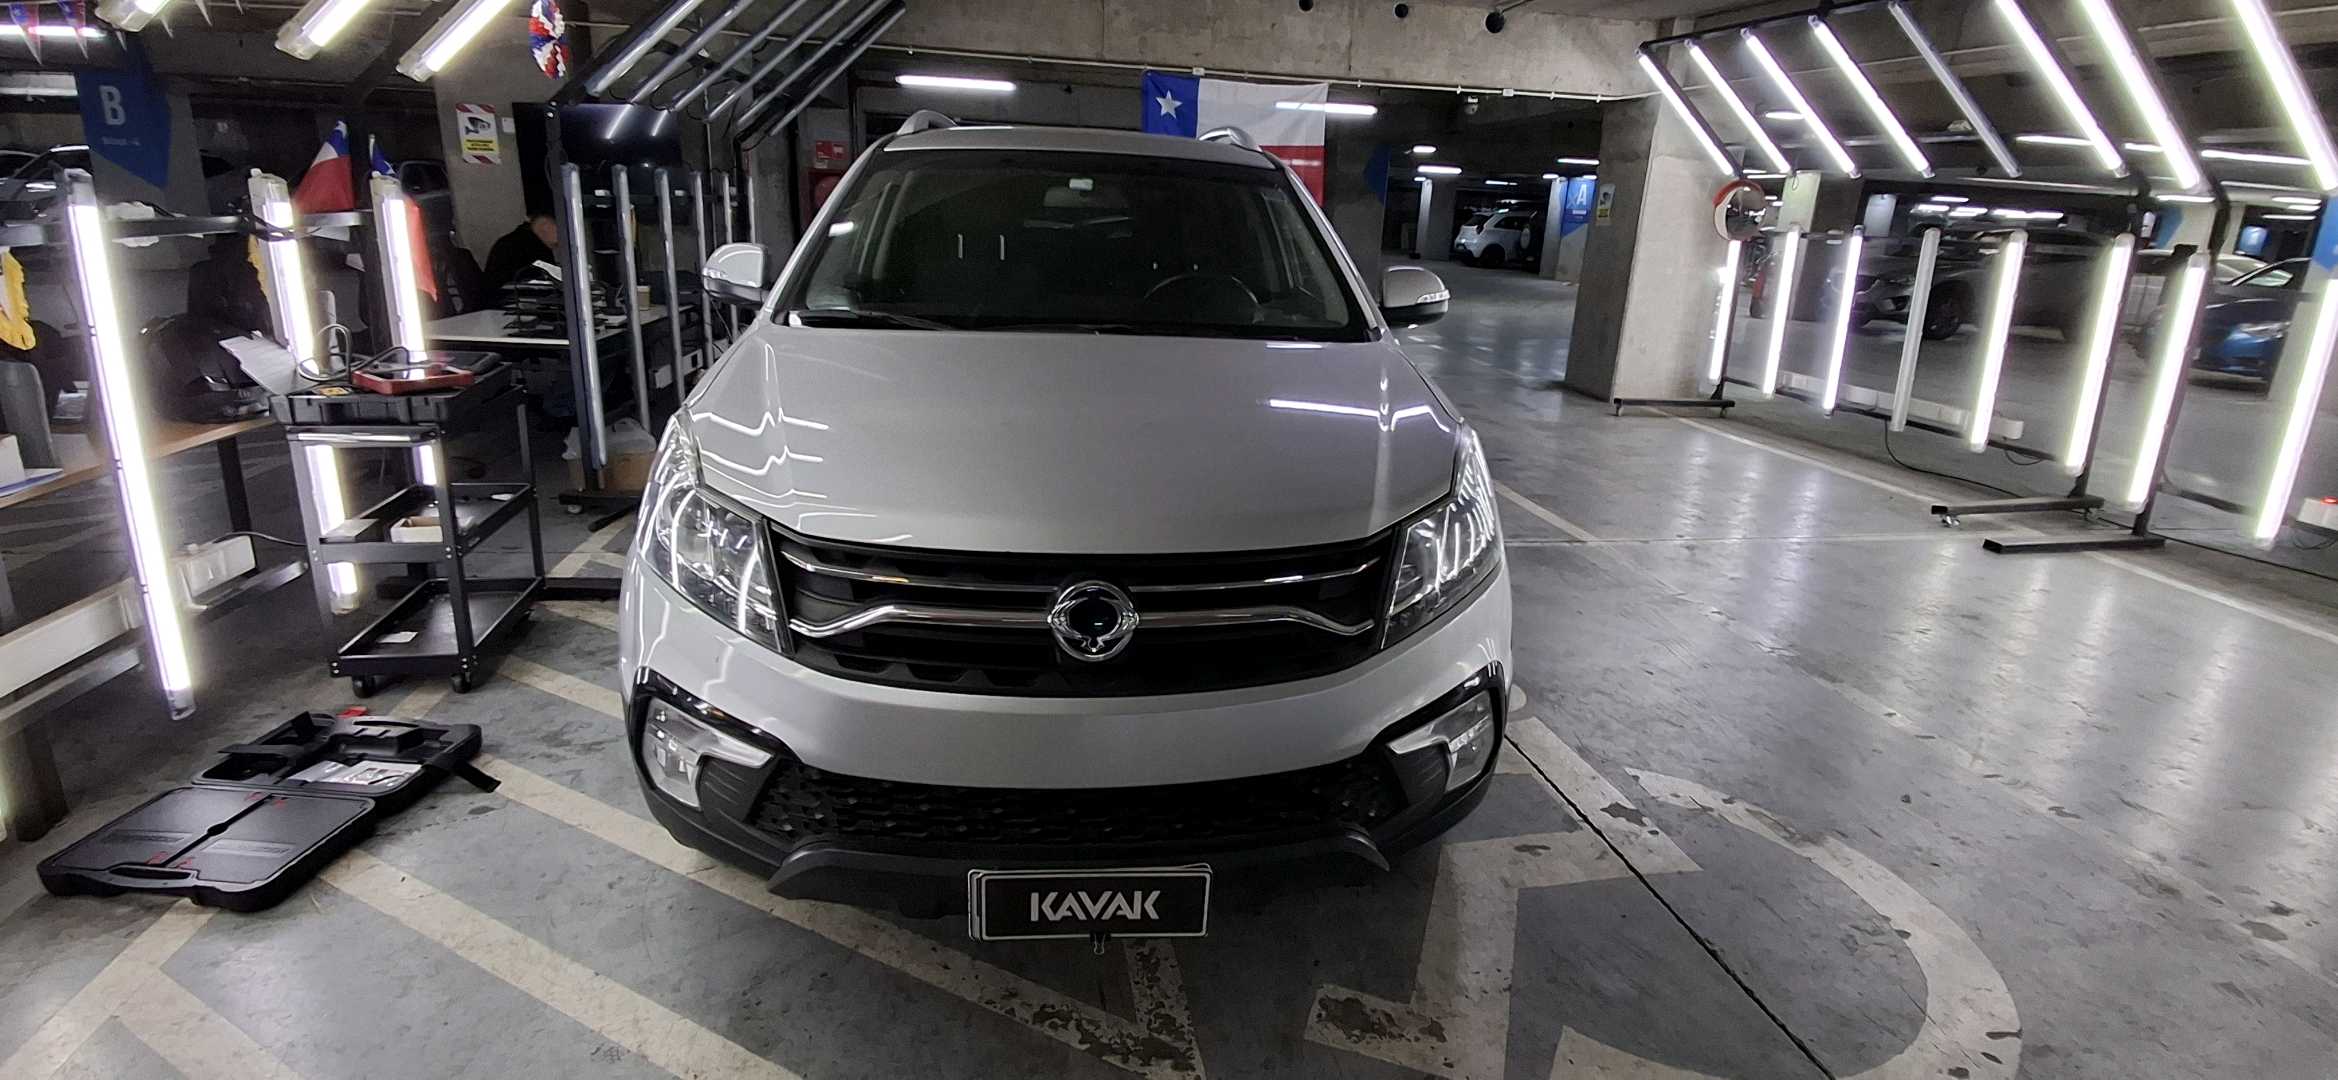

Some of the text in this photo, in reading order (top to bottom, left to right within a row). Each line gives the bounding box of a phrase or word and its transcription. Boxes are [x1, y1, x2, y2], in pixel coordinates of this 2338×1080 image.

[99, 85, 126, 126] B
[1576, 183, 1587, 205] A
[1030, 890, 1161, 922] KAVAK
